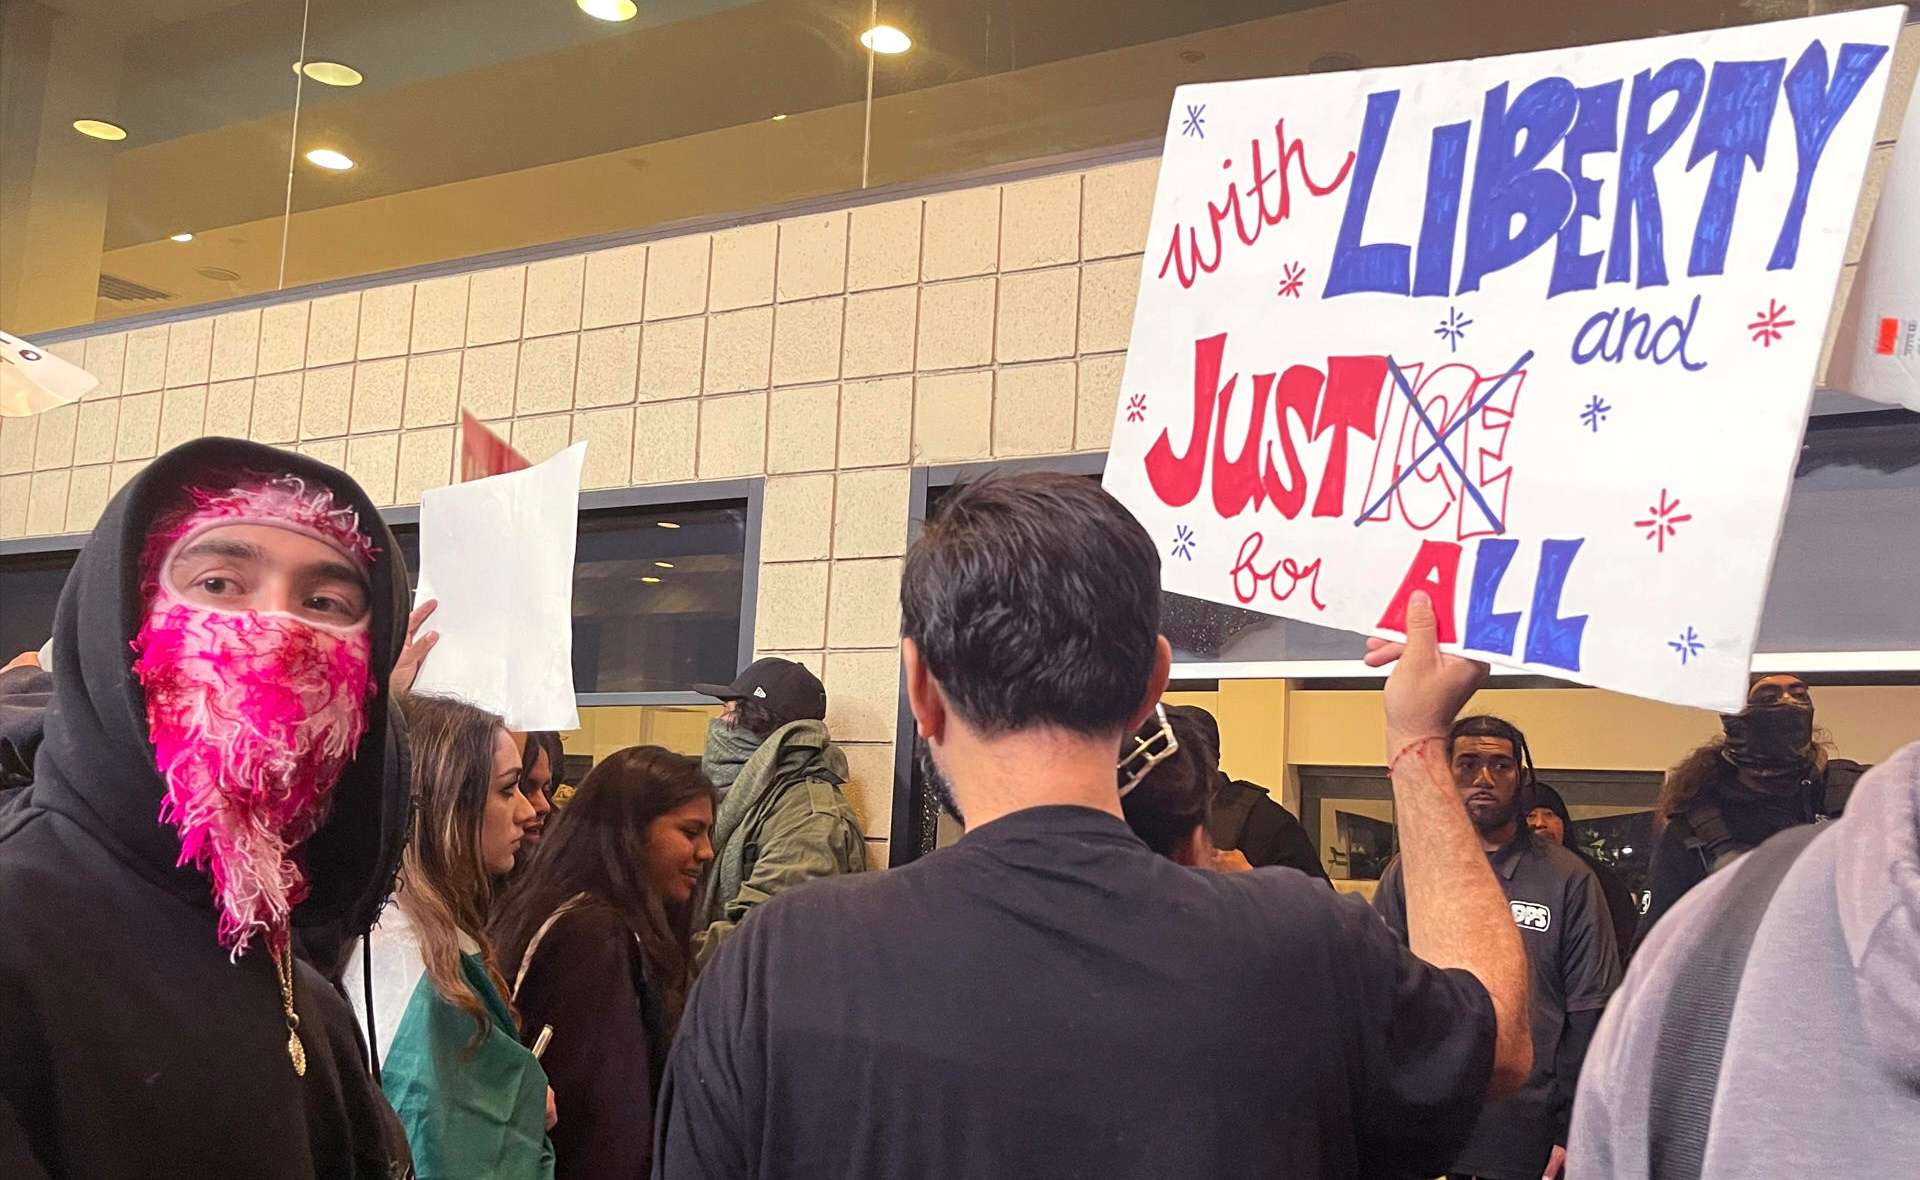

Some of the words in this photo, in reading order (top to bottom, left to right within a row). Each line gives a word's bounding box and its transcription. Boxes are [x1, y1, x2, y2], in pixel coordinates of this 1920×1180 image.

[1159, 119, 1356, 289] with
[1322, 40, 1889, 299] LIBERTY
[1572, 295, 1706, 371] and
[1376, 538, 1589, 672] ALL
